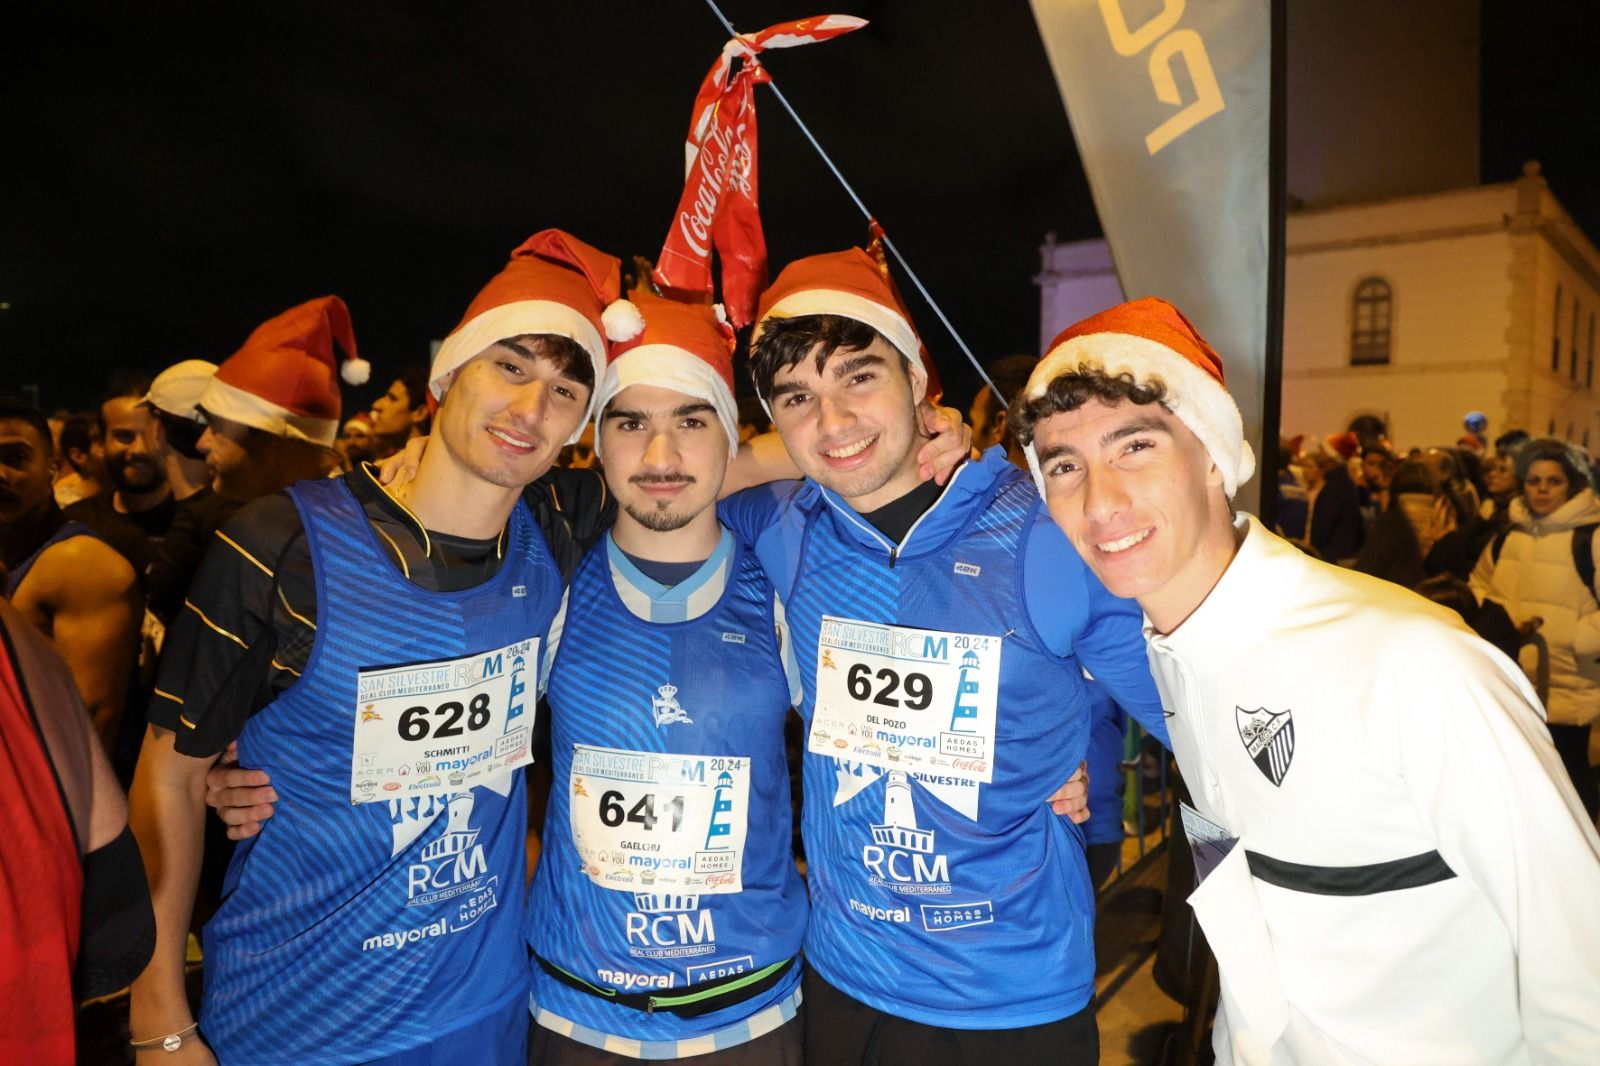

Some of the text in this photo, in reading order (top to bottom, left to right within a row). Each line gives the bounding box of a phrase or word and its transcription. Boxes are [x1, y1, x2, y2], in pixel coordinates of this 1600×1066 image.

[822, 623, 890, 646] SAN SILVESTRE
[892, 632, 948, 659] RCM
[360, 669, 450, 693] SAN SILVESTRE
[453, 653, 503, 687] RCM
[847, 663, 934, 711] 629
[398, 693, 491, 742] 628
[866, 714, 881, 725] DEL
[883, 717, 907, 730] POZO
[876, 729, 936, 749] mayoral
[946, 737, 978, 747] AEDAS
[946, 744, 977, 754] HOMES
[424, 745, 470, 759] SCHMITTI
[436, 746, 493, 771] mayoral
[593, 754, 645, 771] SILVESTRE
[710, 759, 741, 771] 2024
[913, 772, 976, 787] SILVESTRE
[599, 790, 685, 833] 641
[620, 841, 661, 852] GAELCHU
[408, 844, 488, 899] RCM
[629, 855, 692, 871] mayoral
[863, 845, 950, 883] RCM
[849, 898, 911, 923] mayoral
[362, 918, 447, 951] mayoral
[626, 909, 715, 946] RCM
[597, 969, 675, 990] mayoral
[699, 964, 745, 982] AEDAS
